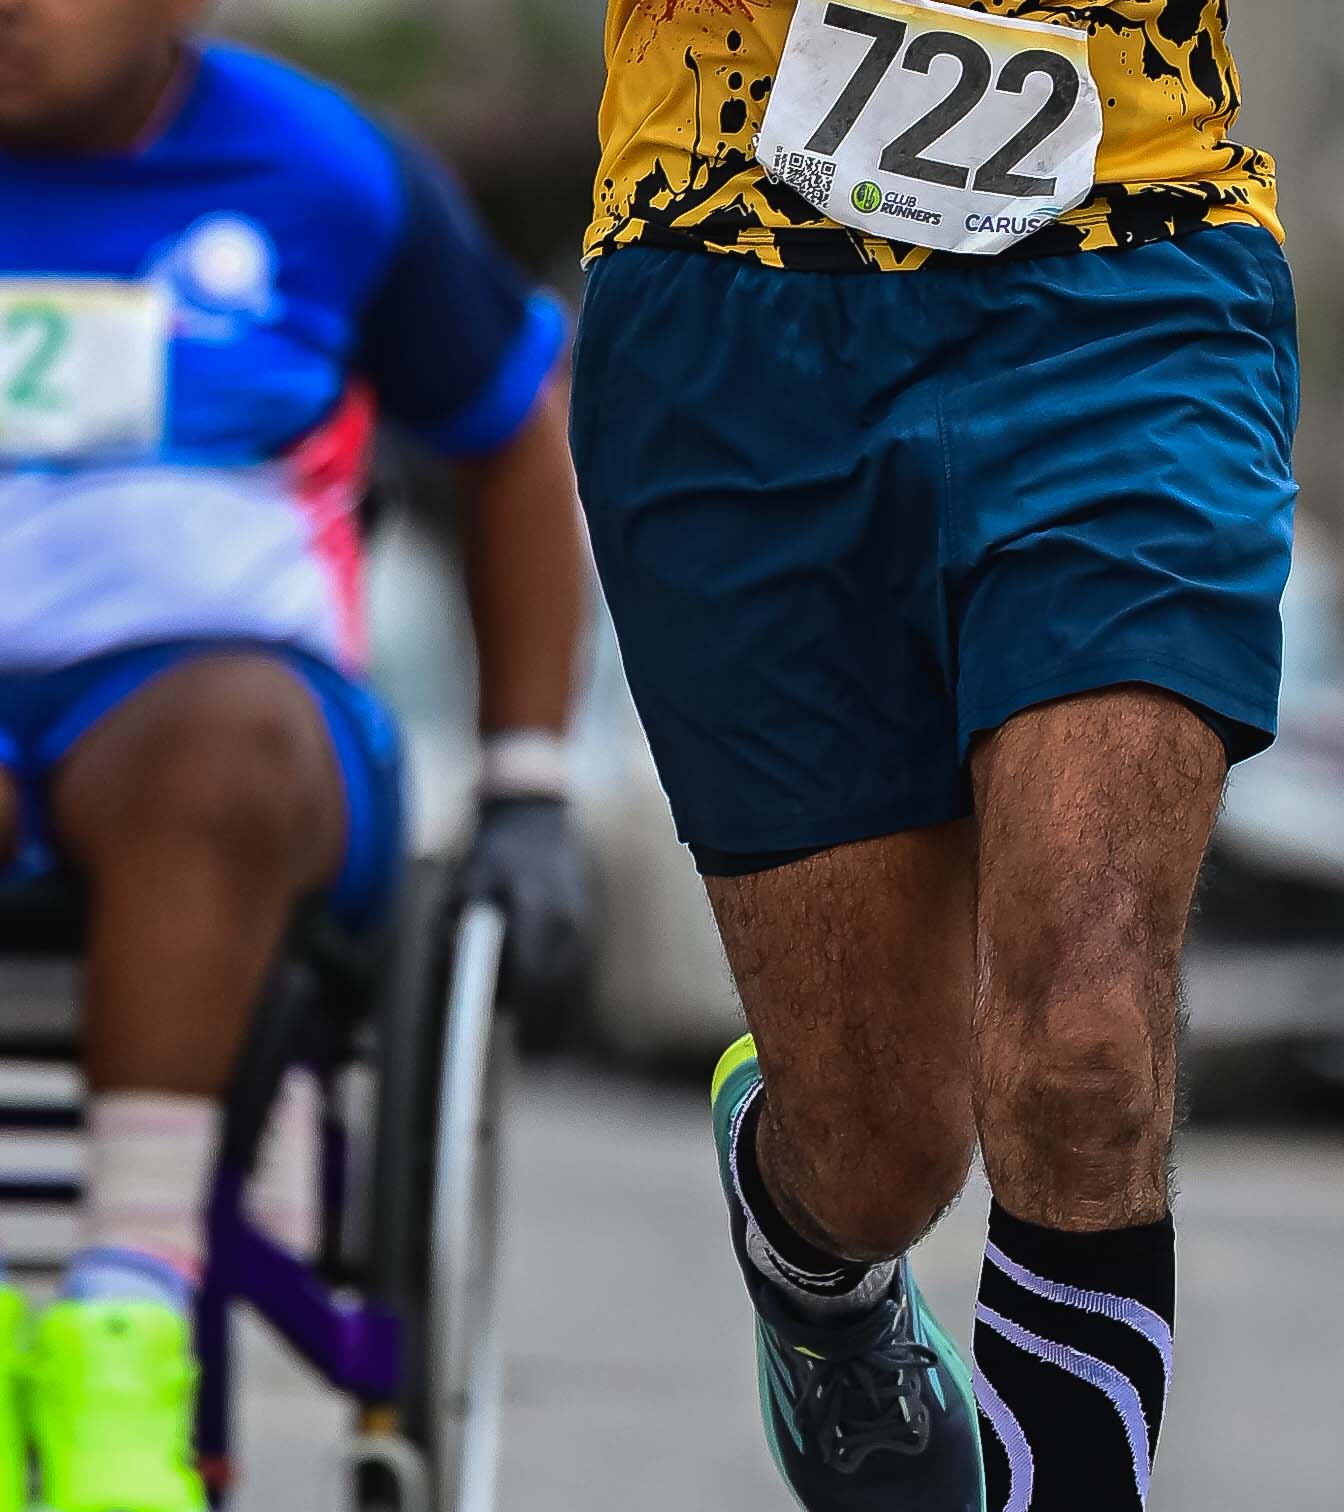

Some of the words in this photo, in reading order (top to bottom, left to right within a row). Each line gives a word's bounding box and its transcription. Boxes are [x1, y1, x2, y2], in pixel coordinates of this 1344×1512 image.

[803, 1, 1080, 197] 722
[884, 191, 917, 208] CLUB
[965, 213, 1054, 236] CARUS
